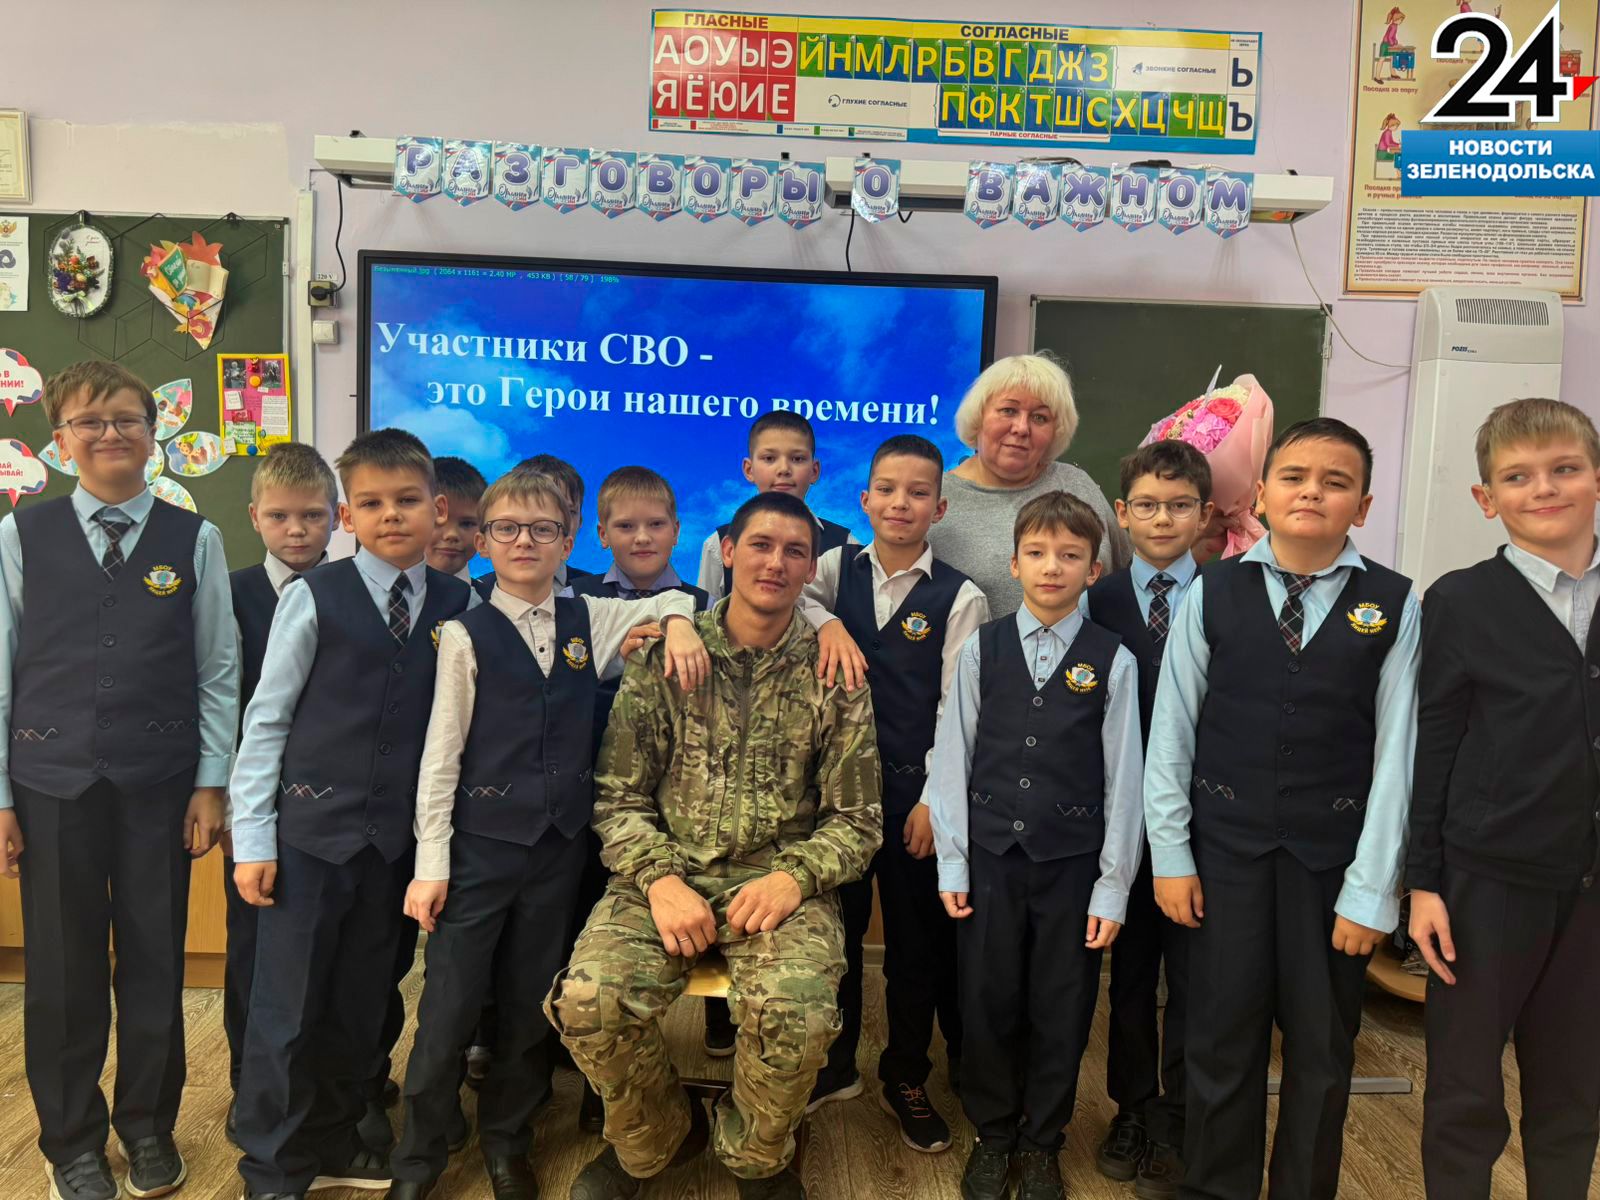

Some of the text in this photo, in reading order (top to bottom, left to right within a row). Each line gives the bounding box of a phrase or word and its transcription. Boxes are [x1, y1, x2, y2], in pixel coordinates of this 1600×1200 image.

[684, 13, 769, 30] ГЛАСНЫЕ
[960, 25, 1070, 42] СОГЛАСНЫЕ
[868, 100, 908, 108] СОГЛАСНЫЕ
[405, 145, 1248, 213] РАЗГОВОРЫ О ВАЖНОМ
[376, 322, 588, 363] Участники
[599, 333, 689, 367] СВО
[426, 376, 940, 426] это Герои нашего времени!
